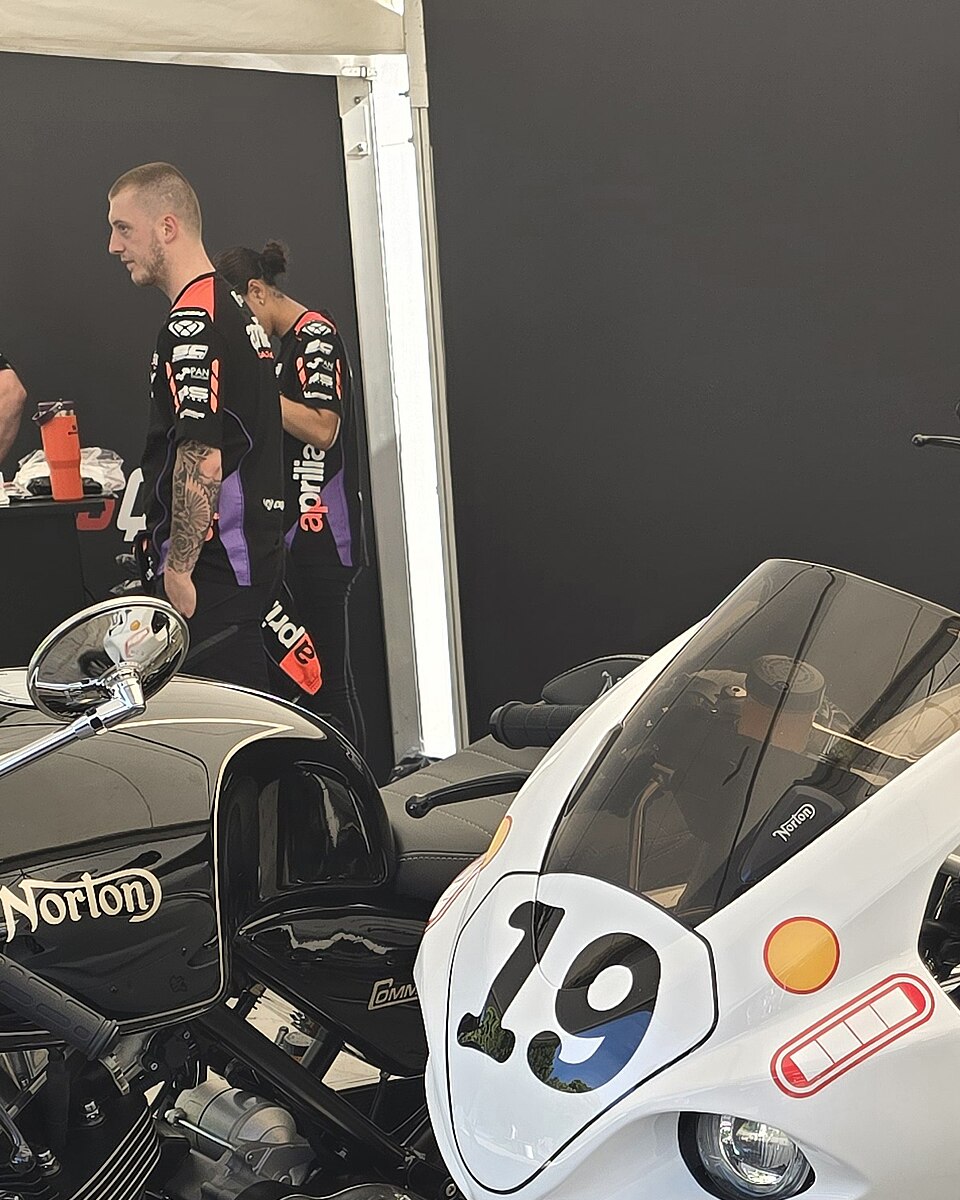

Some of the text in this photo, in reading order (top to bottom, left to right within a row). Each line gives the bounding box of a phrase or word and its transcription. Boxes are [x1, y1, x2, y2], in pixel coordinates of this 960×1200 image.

[261, 600, 316, 666] apri
[771, 803, 816, 842] Norton
[0, 867, 163, 944] Norton
[457, 900, 662, 1094] 19
